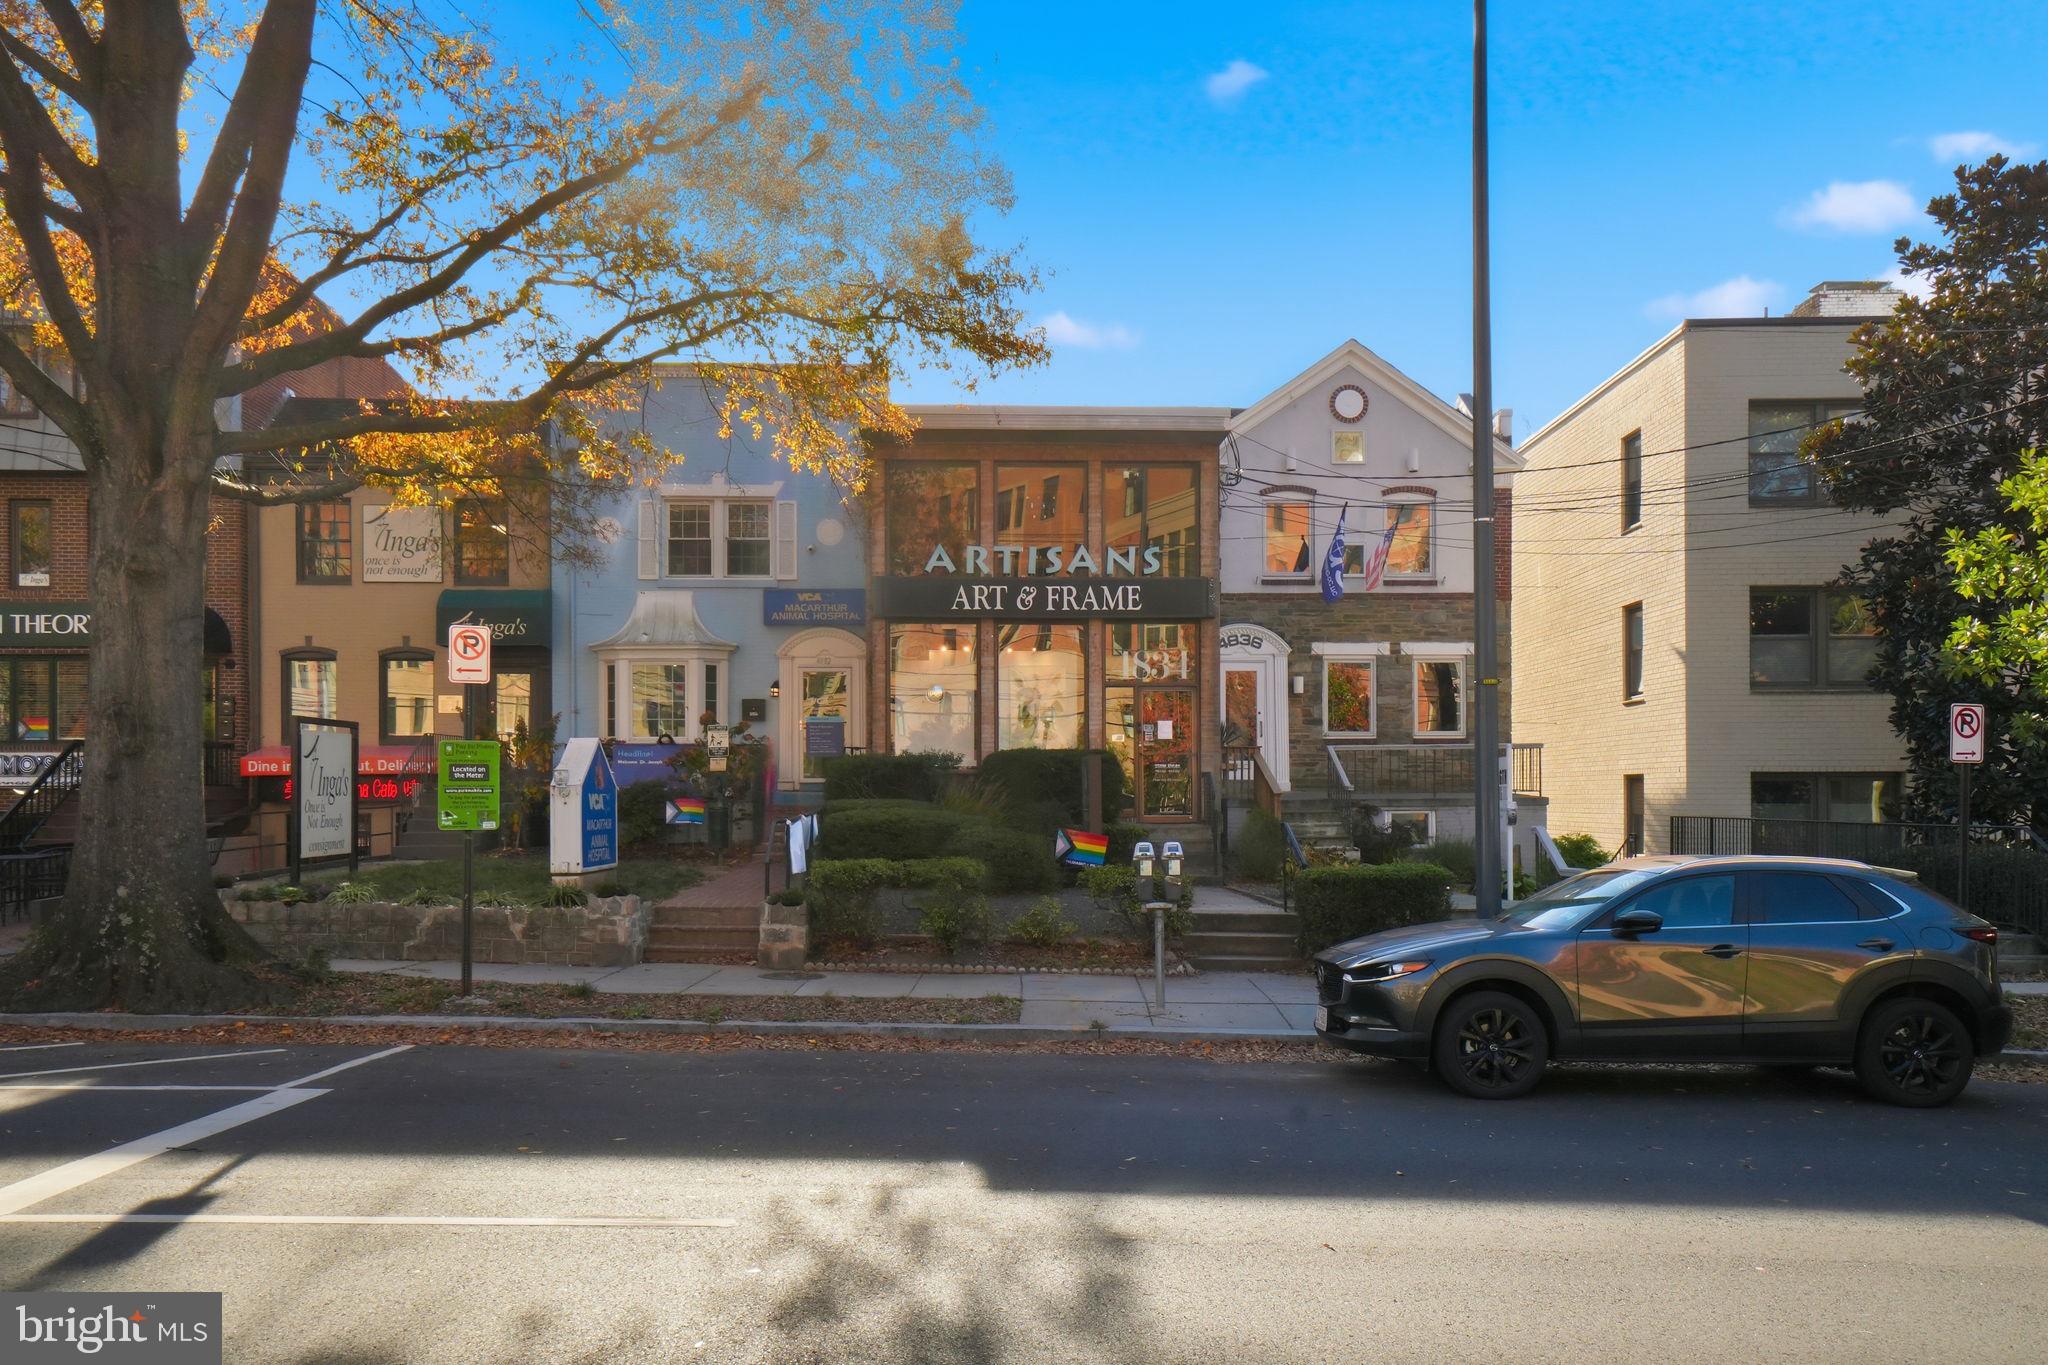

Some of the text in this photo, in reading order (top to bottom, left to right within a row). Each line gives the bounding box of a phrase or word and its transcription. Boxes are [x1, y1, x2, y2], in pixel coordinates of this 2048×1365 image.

[365, 555, 401, 566] once is
[924, 544, 1162, 576] ARTISANS
[366, 564, 428, 578] not enough
[951, 585, 1142, 611] ART & FRAME
[784, 604, 848, 612] MACARTHUR
[10, 614, 91, 634] THEOR
[771, 612, 860, 621] ANIMAL HOSPITAL
[1220, 634, 1263, 649] 4836
[248, 761, 279, 772] Dine
[318, 767, 348, 805] Inga's
[589, 793, 605, 810] VCA
